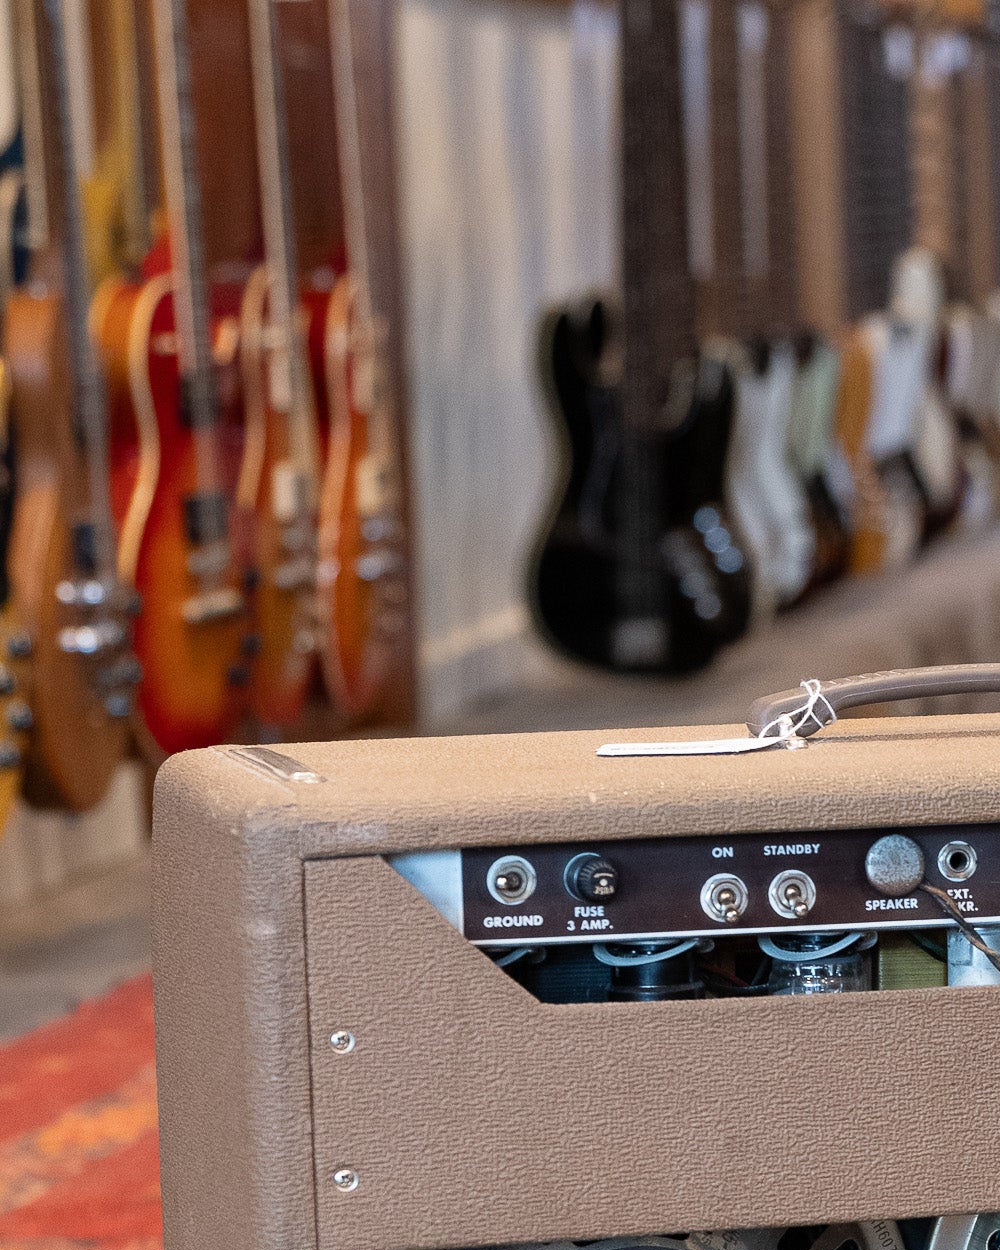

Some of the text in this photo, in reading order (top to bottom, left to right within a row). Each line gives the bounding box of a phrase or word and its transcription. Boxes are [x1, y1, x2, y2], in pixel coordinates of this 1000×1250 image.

[711, 846, 734, 858] ON
[763, 843, 820, 856] STANDBY
[865, 898, 919, 911] SPEAKER
[574, 905, 605, 918] FUSE
[483, 915, 544, 929] GROUND
[566, 918, 614, 931] 3 AMP.
